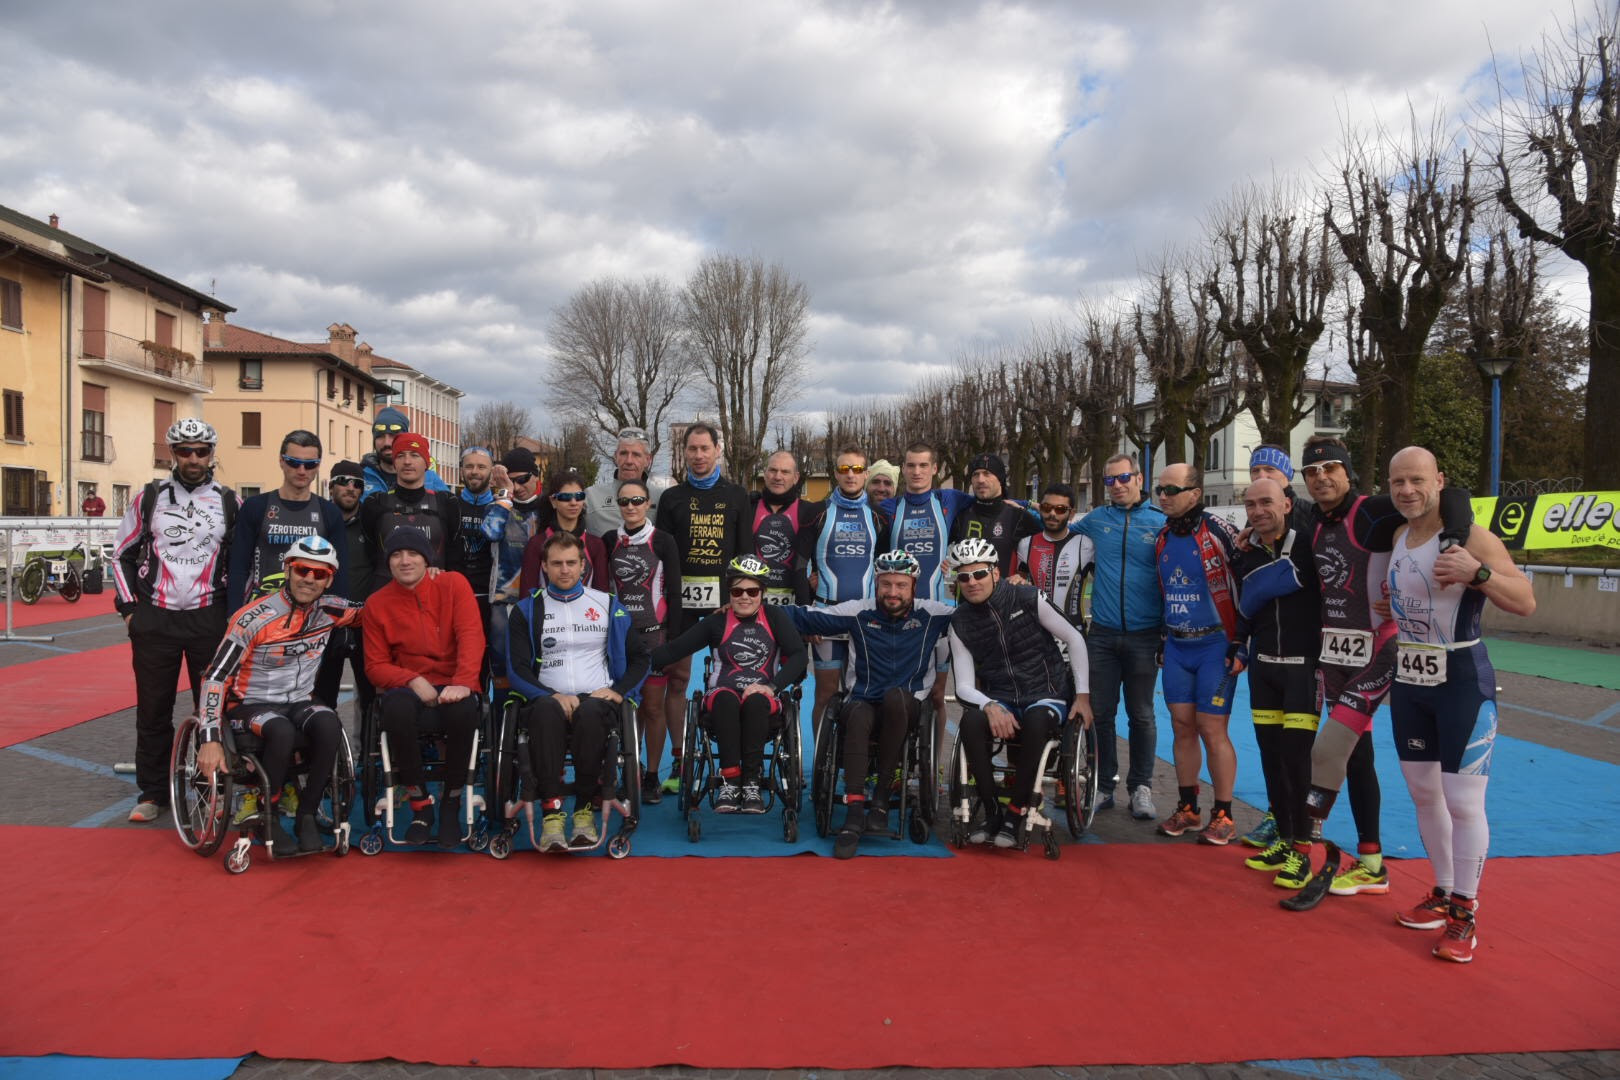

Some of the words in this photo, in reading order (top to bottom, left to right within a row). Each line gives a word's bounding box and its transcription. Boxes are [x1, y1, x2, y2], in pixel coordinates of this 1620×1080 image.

[185, 423, 198, 433] 49
[181, 506, 216, 530] MNERVA
[690, 513, 711, 525] FIAMME
[711, 514, 724, 525] ORO
[268, 524, 318, 536] ZEROTRENTA
[689, 526, 724, 538] FERRARIN
[692, 539, 718, 547] ITA
[1571, 534, 1590, 545] Dove
[689, 548, 722, 556] 2XU
[835, 544, 865, 554] CSS
[905, 542, 934, 553] CSS
[161, 549, 209, 565] TRIATHLON
[741, 560, 758, 572] 433
[682, 586, 713, 601] 437
[1170, 604, 1188, 613] ITA
[1329, 636, 1365, 656] 442
[1402, 653, 1439, 675] 445
